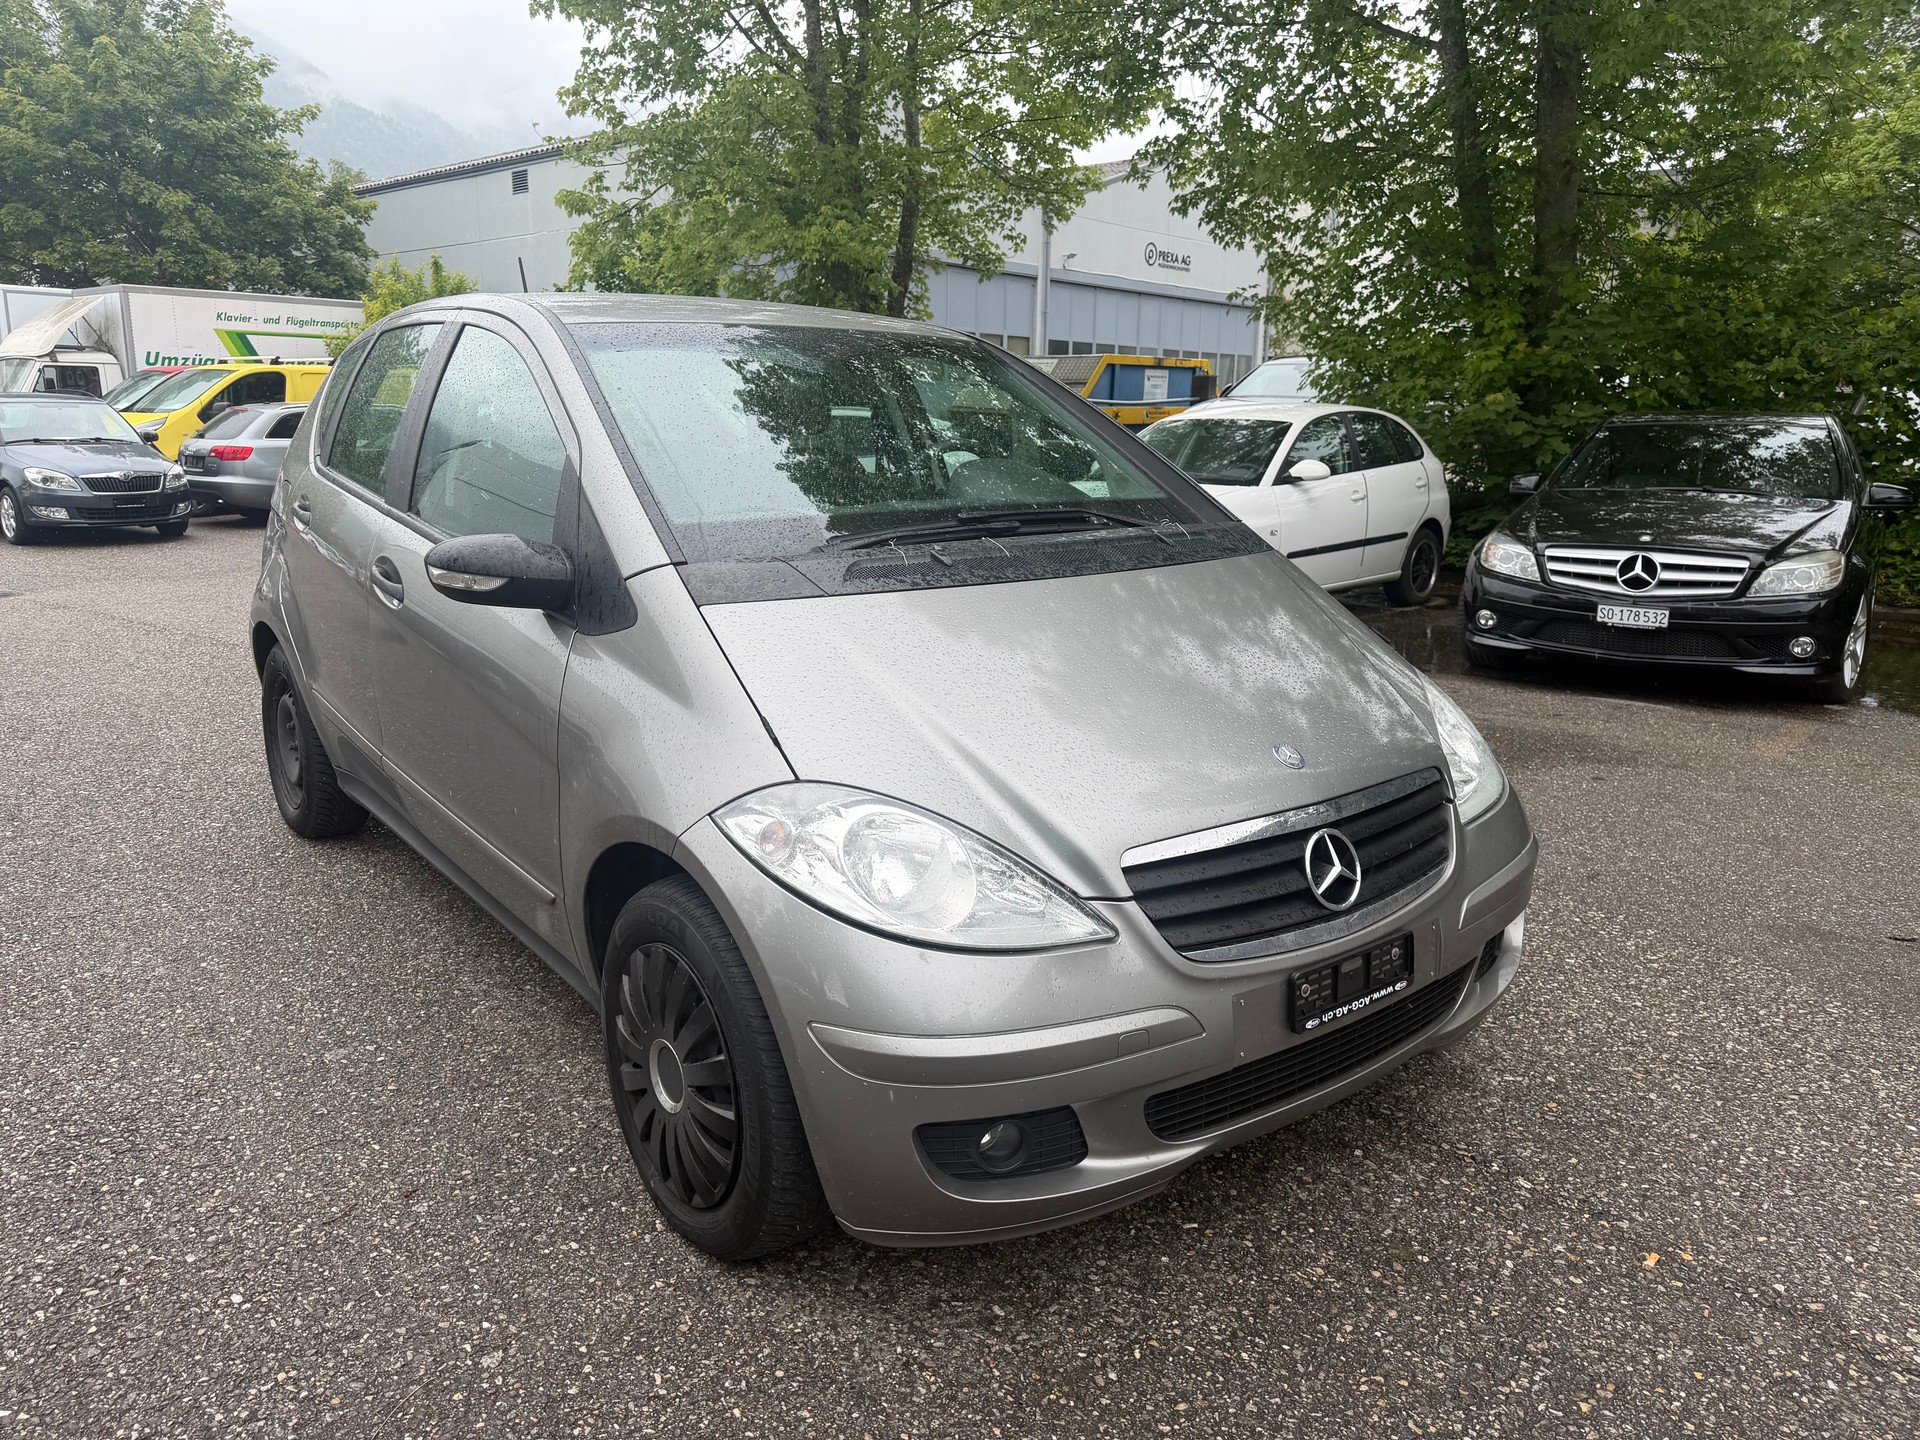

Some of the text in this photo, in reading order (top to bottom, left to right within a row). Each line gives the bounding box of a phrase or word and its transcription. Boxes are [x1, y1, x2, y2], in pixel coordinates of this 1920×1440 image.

[1158, 250, 1191, 266] PREXA AG
[263, 316, 281, 325] und
[286, 316, 360, 330] Flügeltranspote
[1322, 985, 1394, 1023] www.ACG-AG.ch
